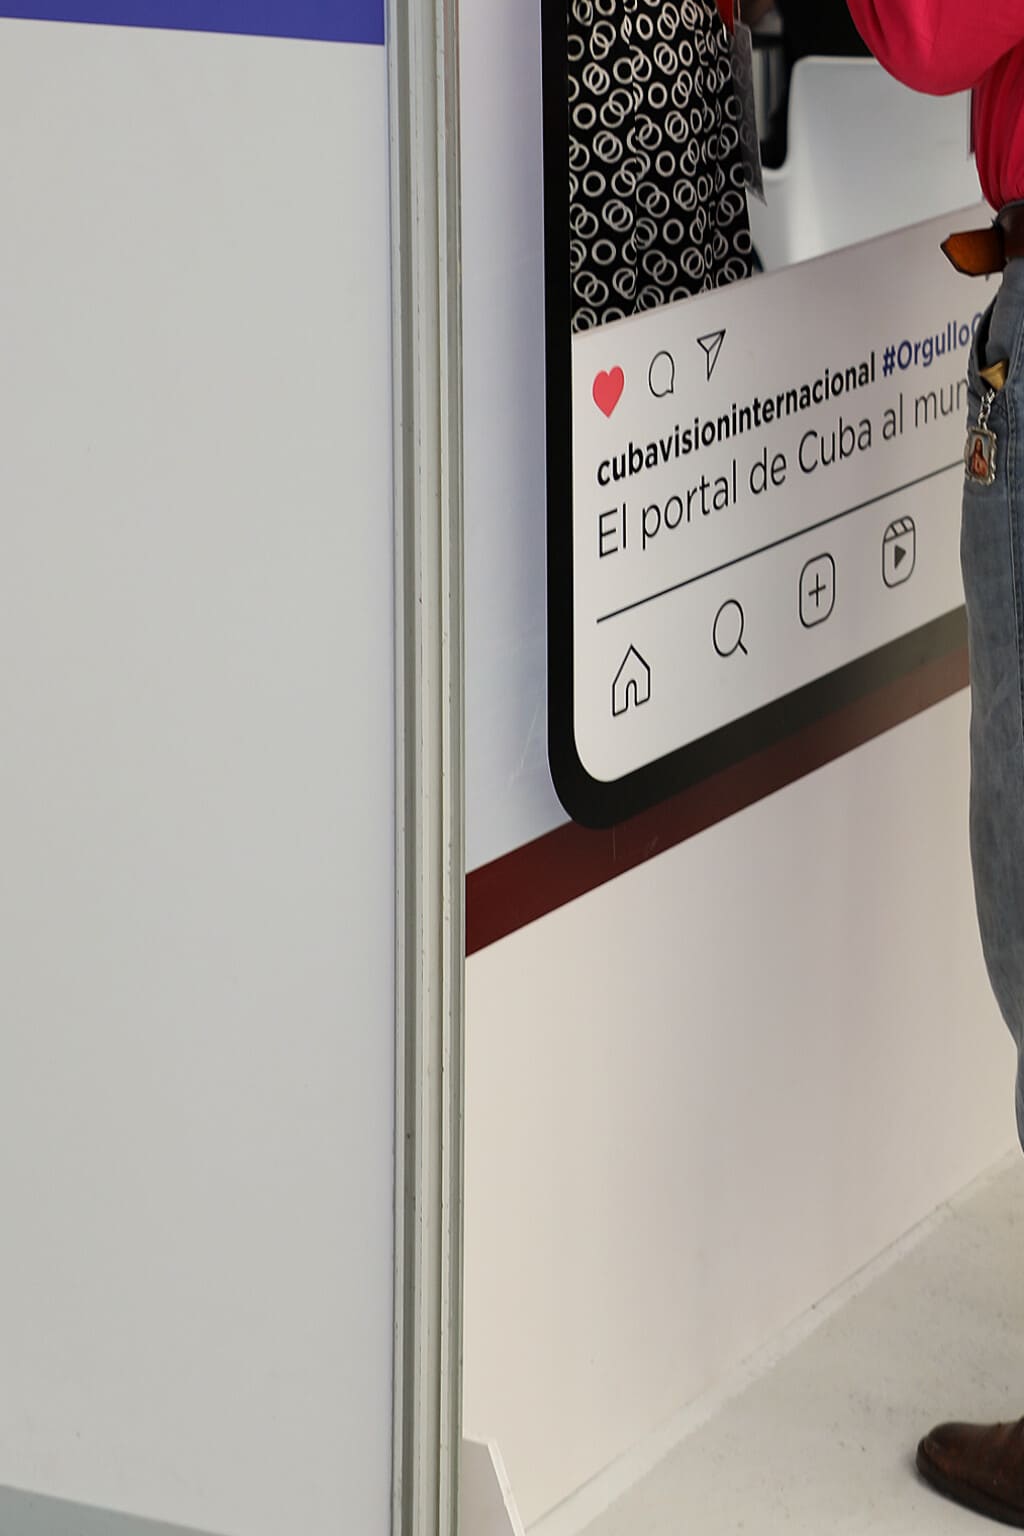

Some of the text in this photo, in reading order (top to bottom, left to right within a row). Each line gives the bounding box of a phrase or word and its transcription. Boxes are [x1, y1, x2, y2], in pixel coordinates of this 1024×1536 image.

[597, 351, 877, 486] cubavisioninternacional
[599, 504, 627, 558] El
[642, 460, 737, 551] portal
[749, 448, 787, 496] de
[798, 414, 871, 474] Cuba
[882, 393, 904, 441] al
